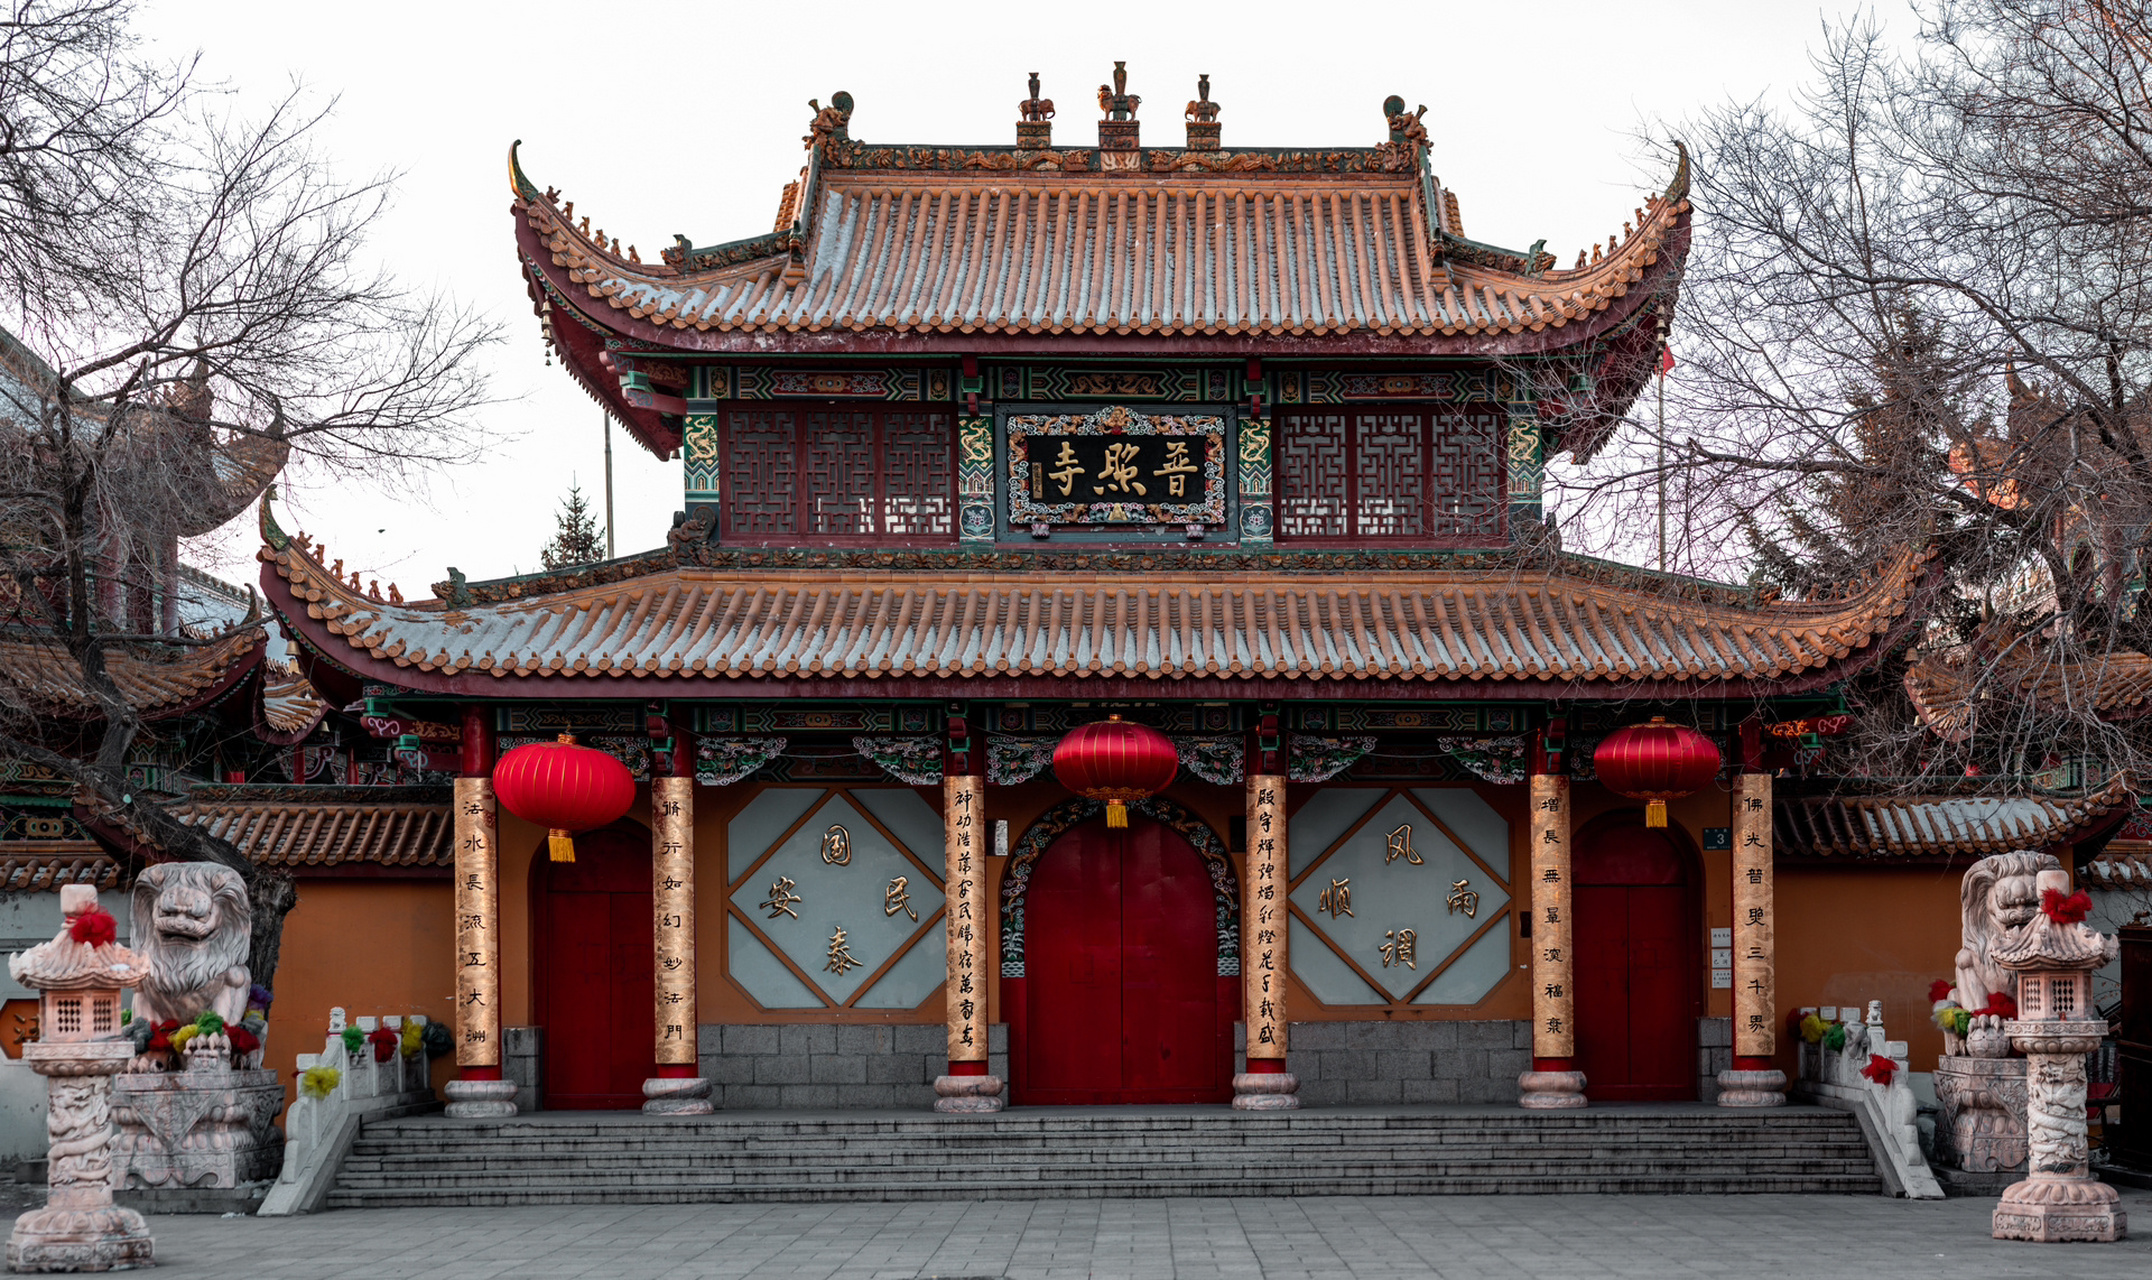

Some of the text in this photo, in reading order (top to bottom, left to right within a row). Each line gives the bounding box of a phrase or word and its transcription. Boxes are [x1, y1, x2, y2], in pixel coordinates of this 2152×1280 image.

[1048, 441, 1199, 498] 普照寺
[1716, 833, 1725, 845] 3
[760, 876, 802, 920] 安
[885, 876, 918, 922] 民
[1447, 879, 1479, 919] 雨
[823, 926, 863, 976] 泰
